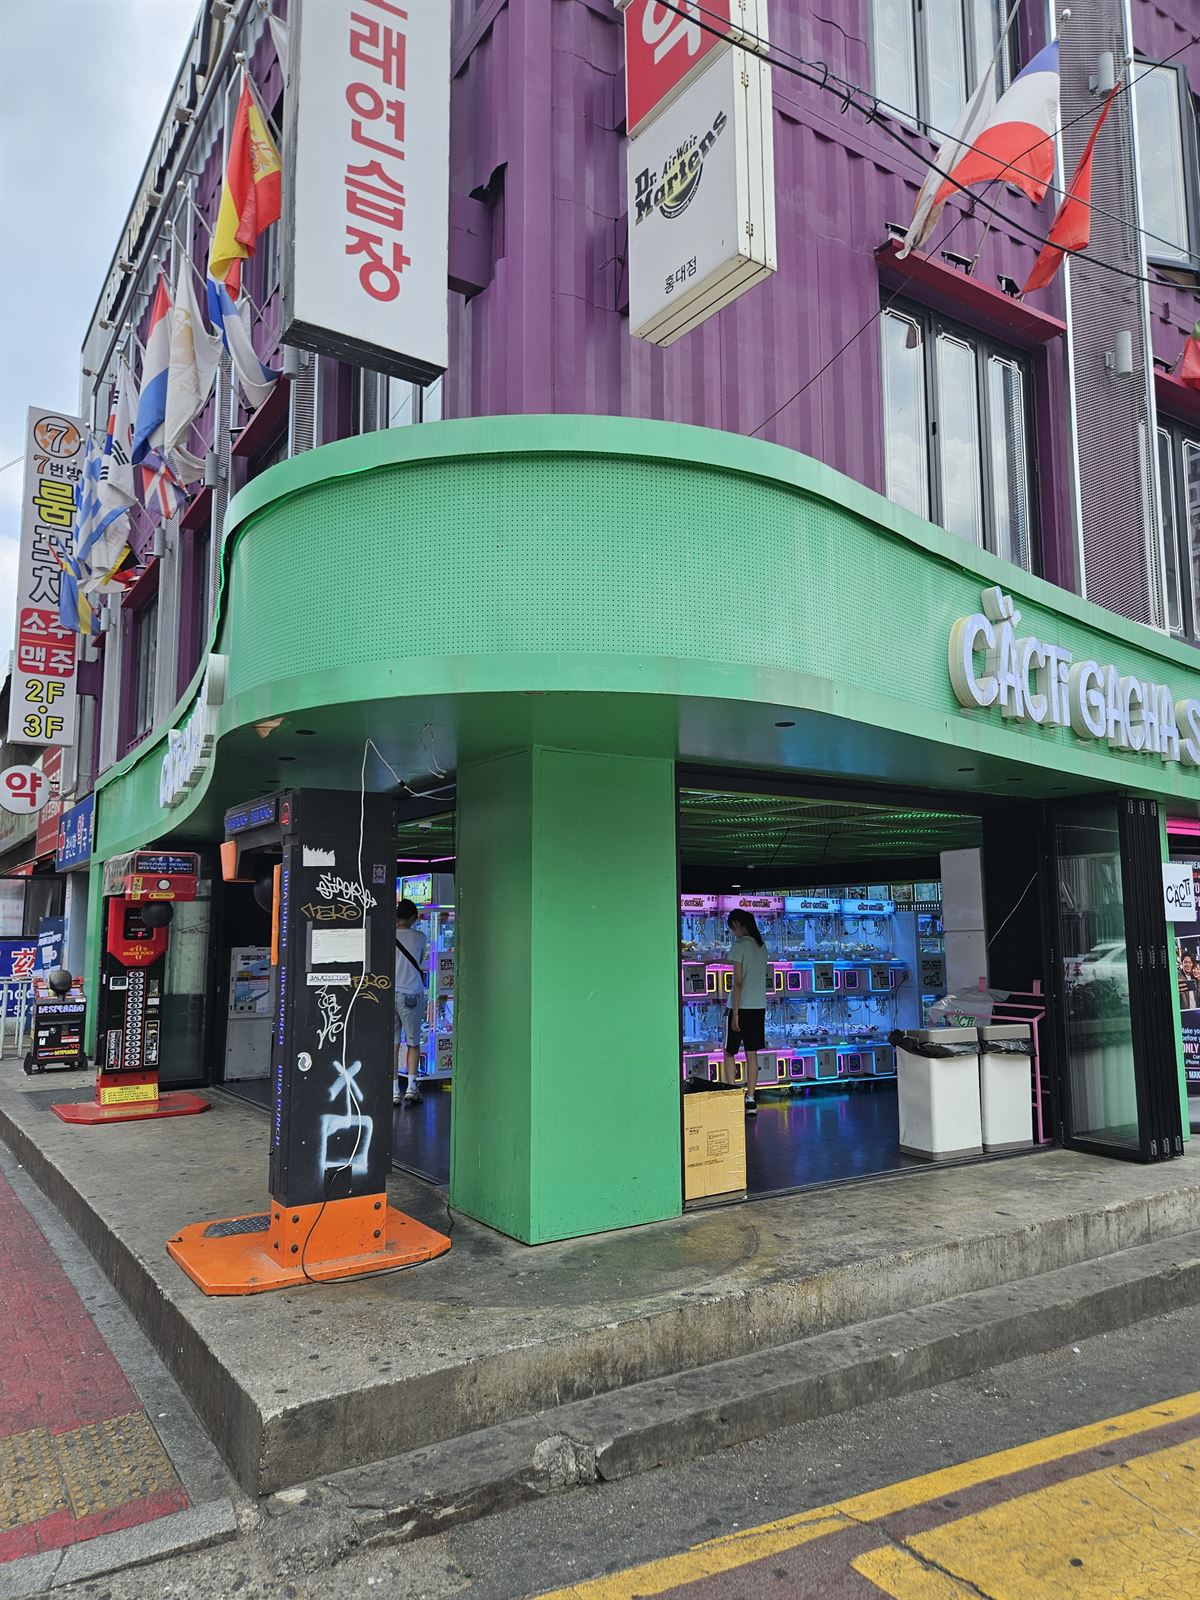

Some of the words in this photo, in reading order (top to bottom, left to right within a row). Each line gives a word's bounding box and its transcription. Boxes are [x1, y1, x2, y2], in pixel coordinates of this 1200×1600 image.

[345, 0, 410, 302] 래연습장
[635, 110, 728, 225] Martens
[634, 167, 658, 201] Dr.
[664, 255, 697, 294] 홍대점
[20, 645, 75, 674] 맥주
[25, 679, 65, 705] 2F
[23, 714, 64, 739] 3F
[1068, 659, 1181, 763] GACHA
[5, 772, 42, 808] 약
